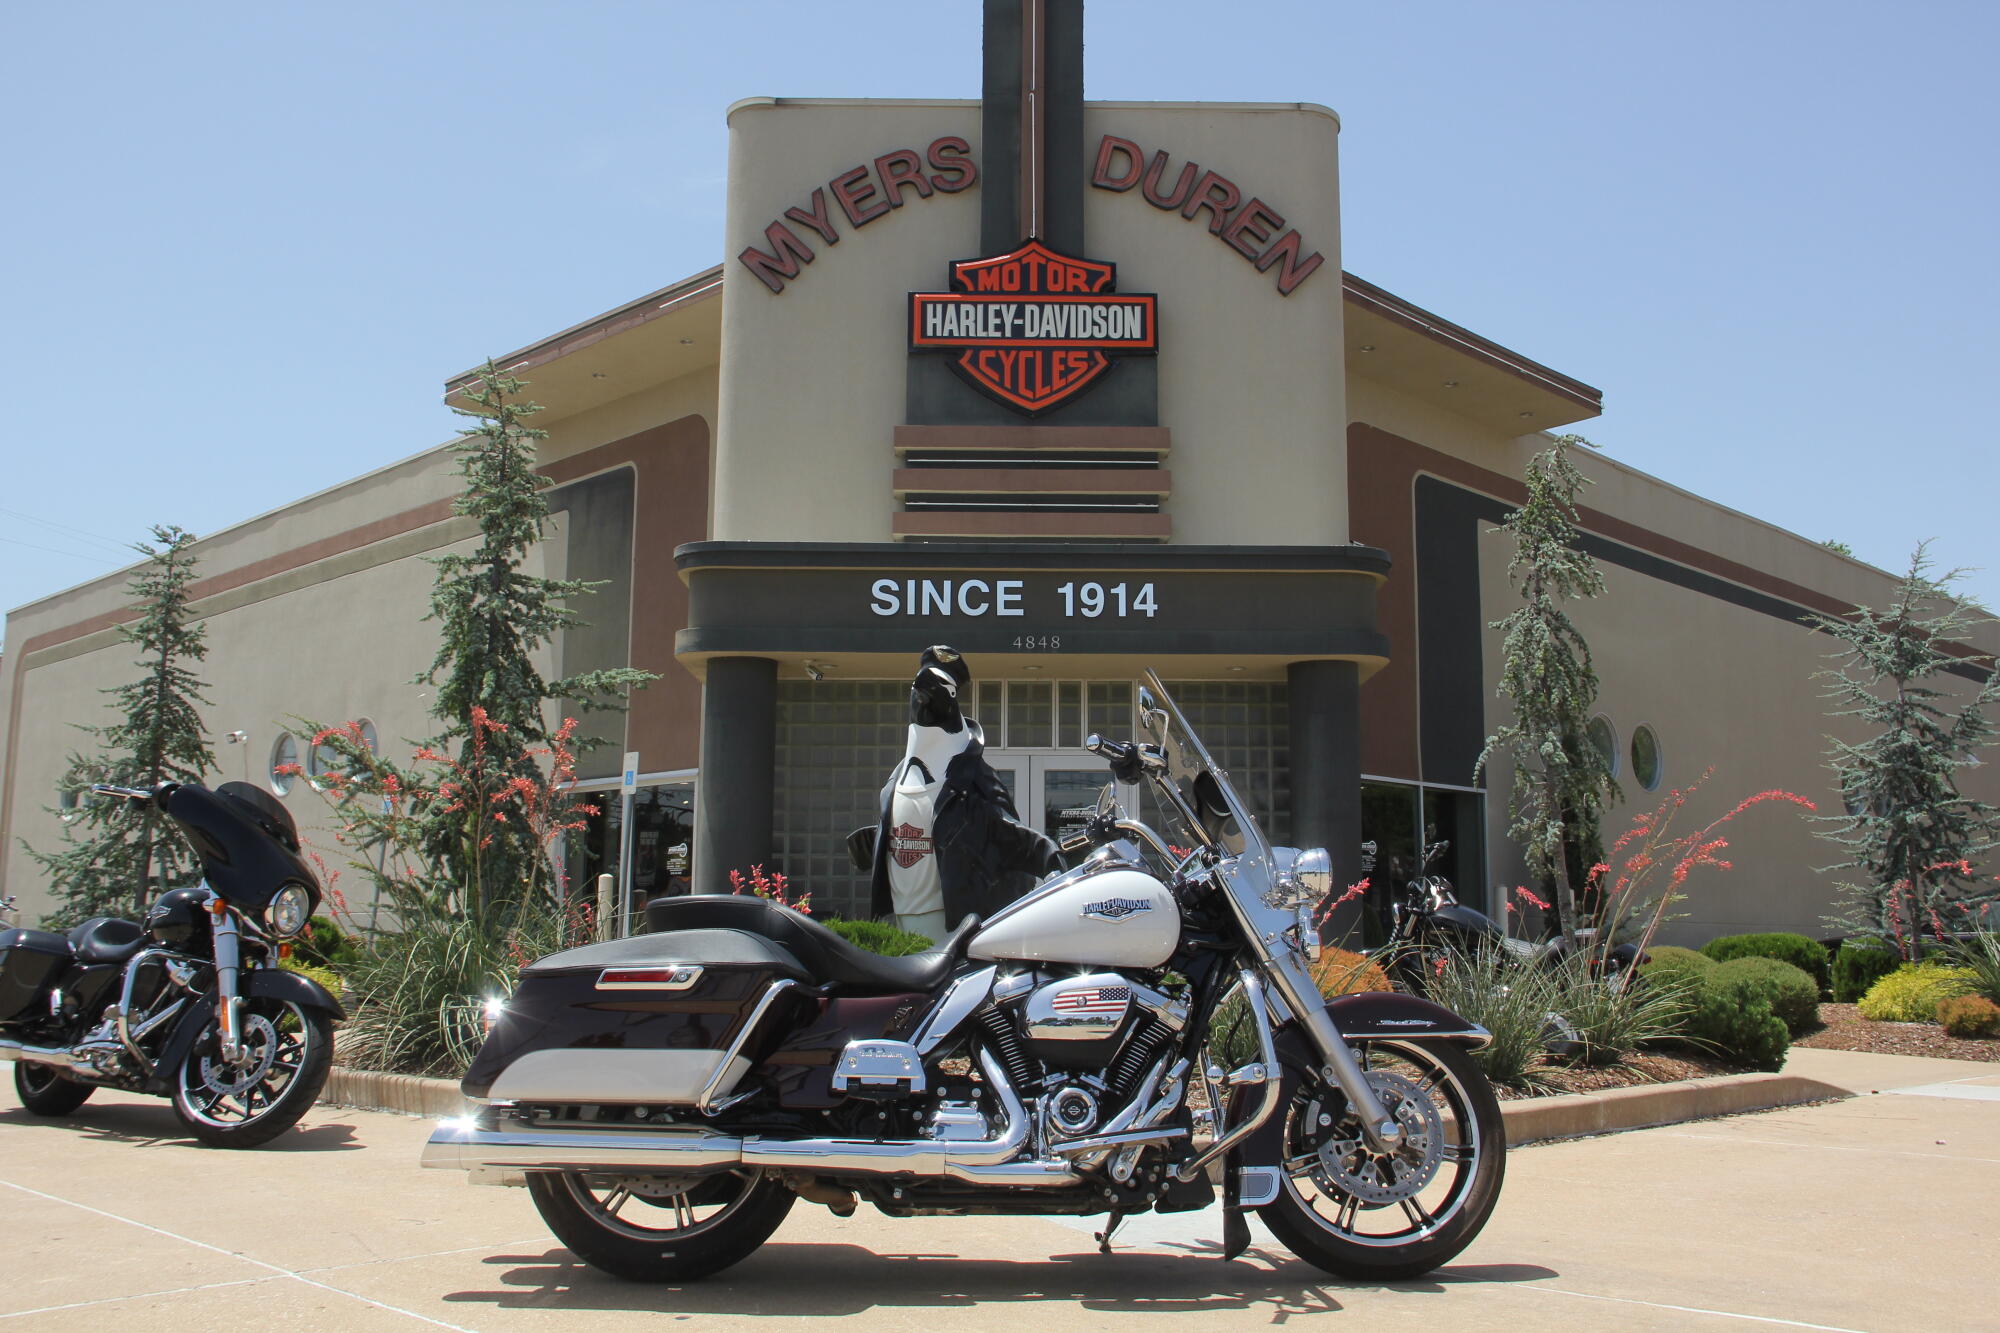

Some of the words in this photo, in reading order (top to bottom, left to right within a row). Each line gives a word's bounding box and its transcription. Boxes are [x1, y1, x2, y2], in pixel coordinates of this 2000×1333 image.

[738, 136, 977, 295] MYERS
[1091, 135, 1325, 296] DUREN
[977, 250, 1090, 292] MOTOR
[926, 303, 1141, 339] HARLEY-DAVIDSON
[978, 350, 1089, 400] CYCLES
[870, 578, 1025, 616] SINCE
[1057, 581, 1159, 618] 1914
[1012, 635, 1061, 650] 4848
[1081, 898, 1152, 915] HARLEY-DAVIDSON
